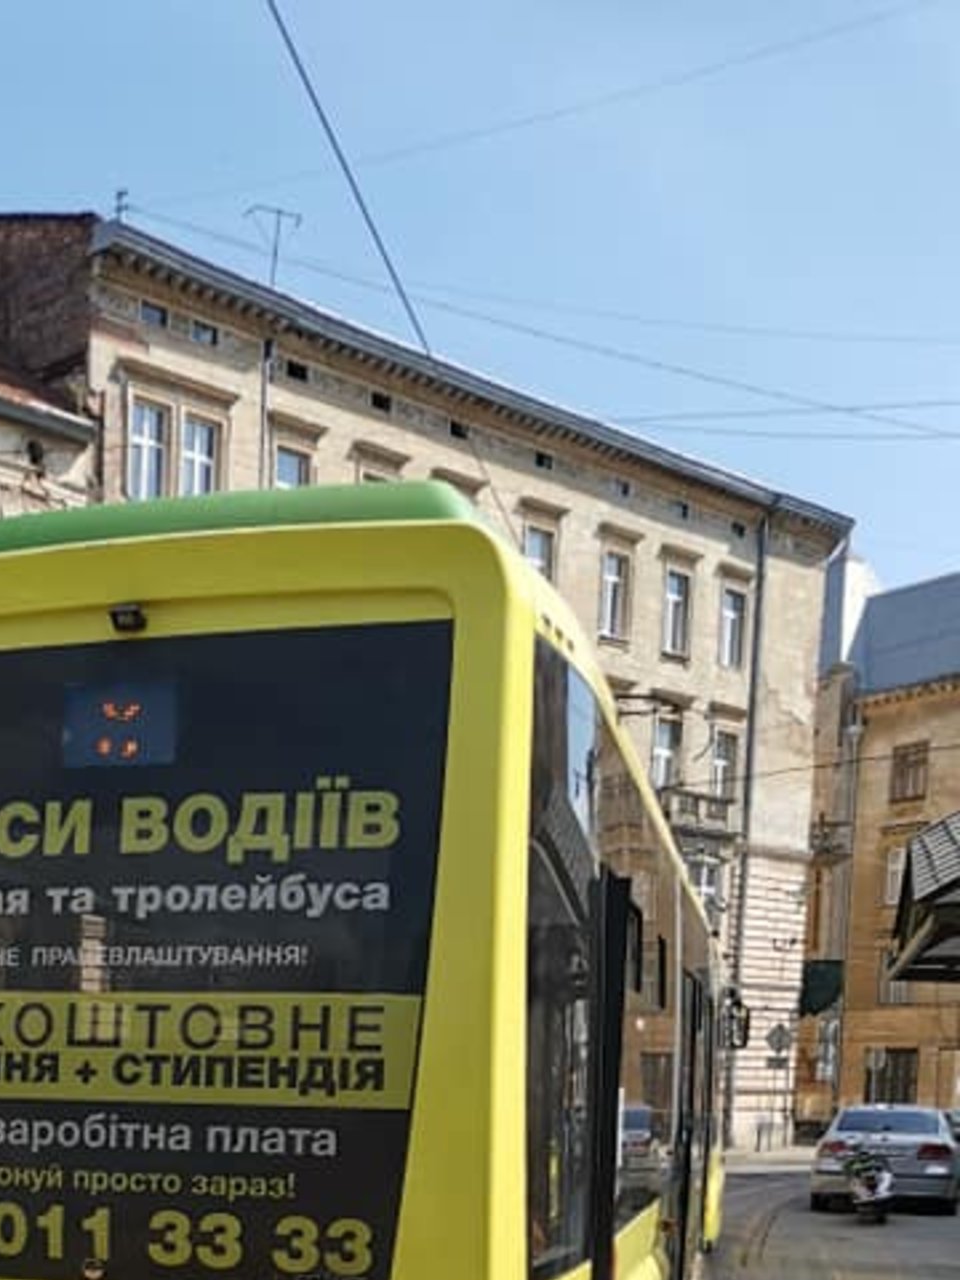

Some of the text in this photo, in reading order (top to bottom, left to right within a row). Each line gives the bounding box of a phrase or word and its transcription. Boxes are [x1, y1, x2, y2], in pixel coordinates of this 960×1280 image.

[119, 776, 402, 865] ВОДІЇВ
[47, 886, 96, 915] та
[112, 876, 391, 917] тролейбуса
[112, 1054, 386, 1096] СТИПЕНДІЯ
[207, 1125, 338, 1157] плата
[73, 1168, 182, 1194] просто
[192, 1173, 295, 1201] зараз!
[148, 1210, 242, 1269] 33
[272, 1216, 373, 1275] 33
